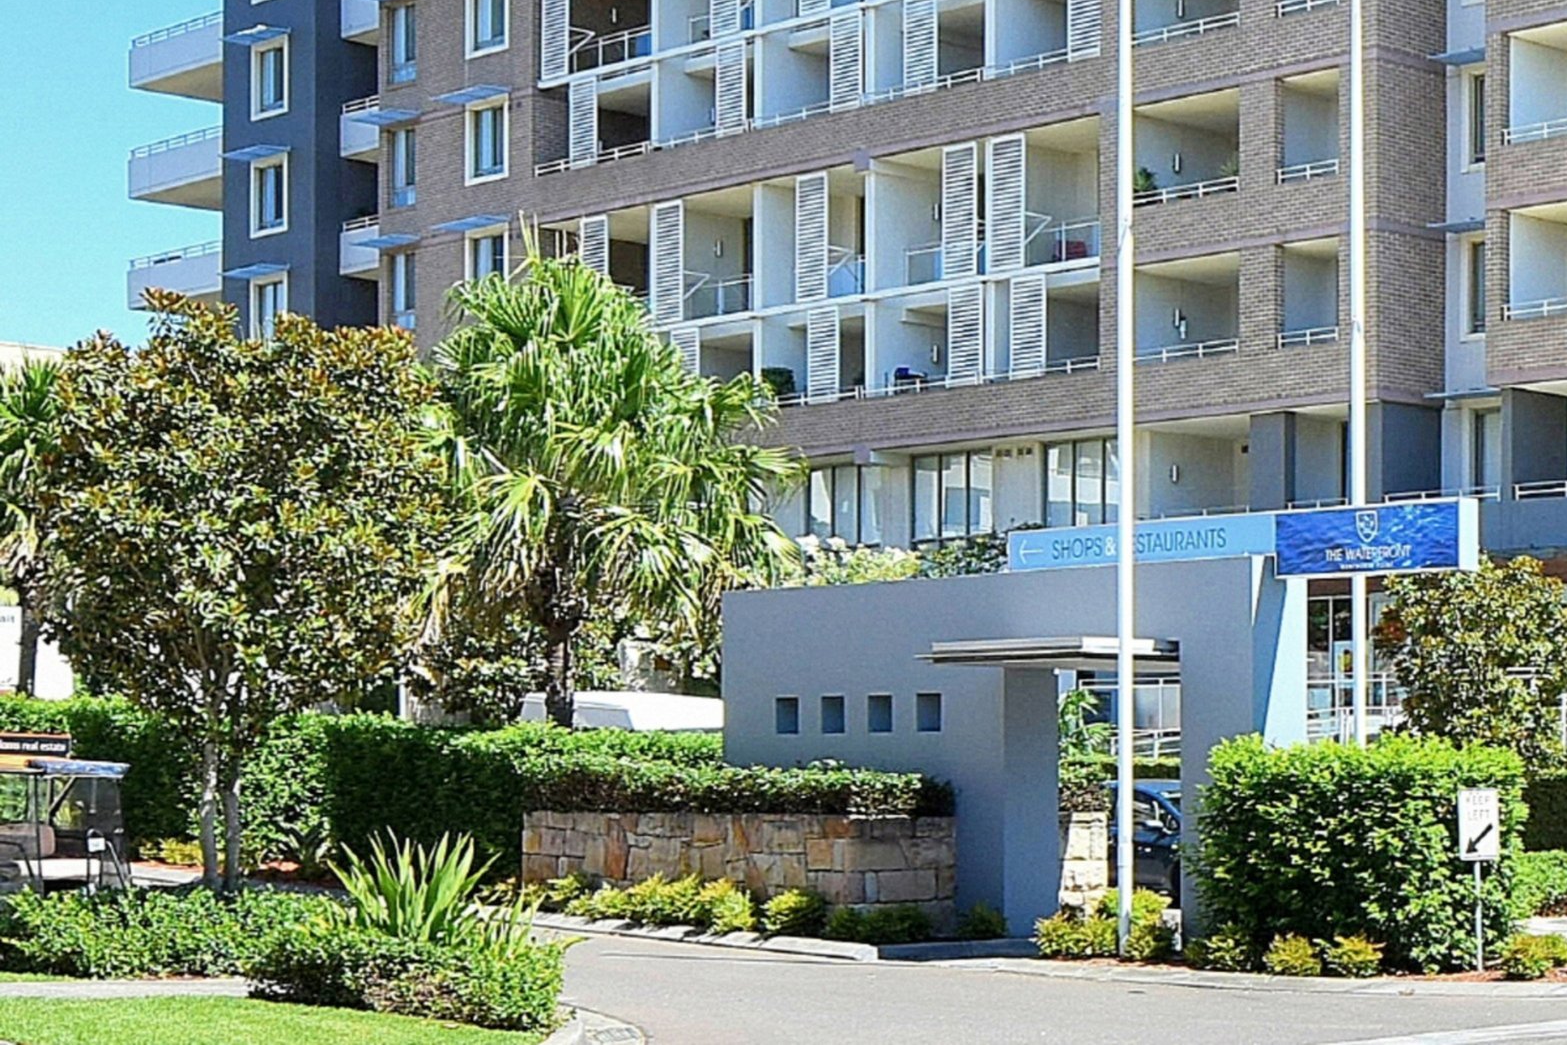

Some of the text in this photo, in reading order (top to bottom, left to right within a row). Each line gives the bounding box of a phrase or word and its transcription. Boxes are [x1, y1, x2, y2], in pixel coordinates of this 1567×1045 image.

[1052, 537, 1103, 560] SHOPS
[1133, 527, 1227, 554] STAURANTS
[1325, 544, 1412, 562] THE WATERFRONT
[22, 741, 39, 751] real
[40, 743, 66, 752] estate
